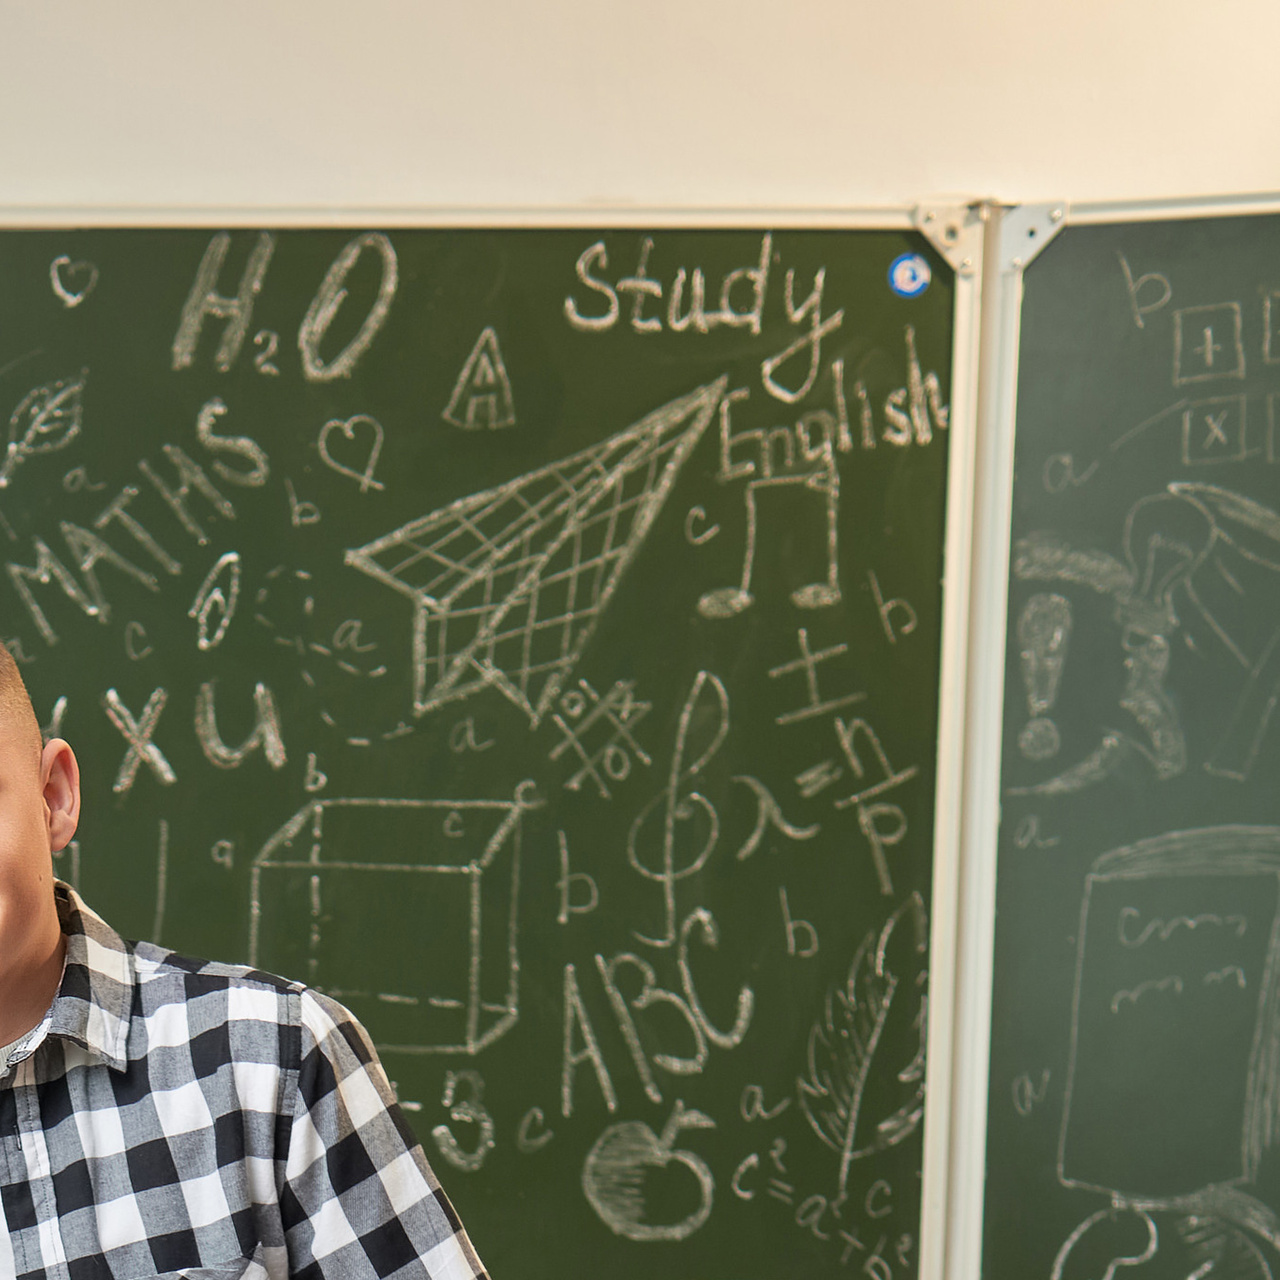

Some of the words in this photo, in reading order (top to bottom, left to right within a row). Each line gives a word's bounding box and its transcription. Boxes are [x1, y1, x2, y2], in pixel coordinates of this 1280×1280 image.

[564, 232, 844, 403] Study
[718, 325, 950, 481] English
[5, 397, 271, 646] MATHS
[561, 906, 756, 1118] ABC
